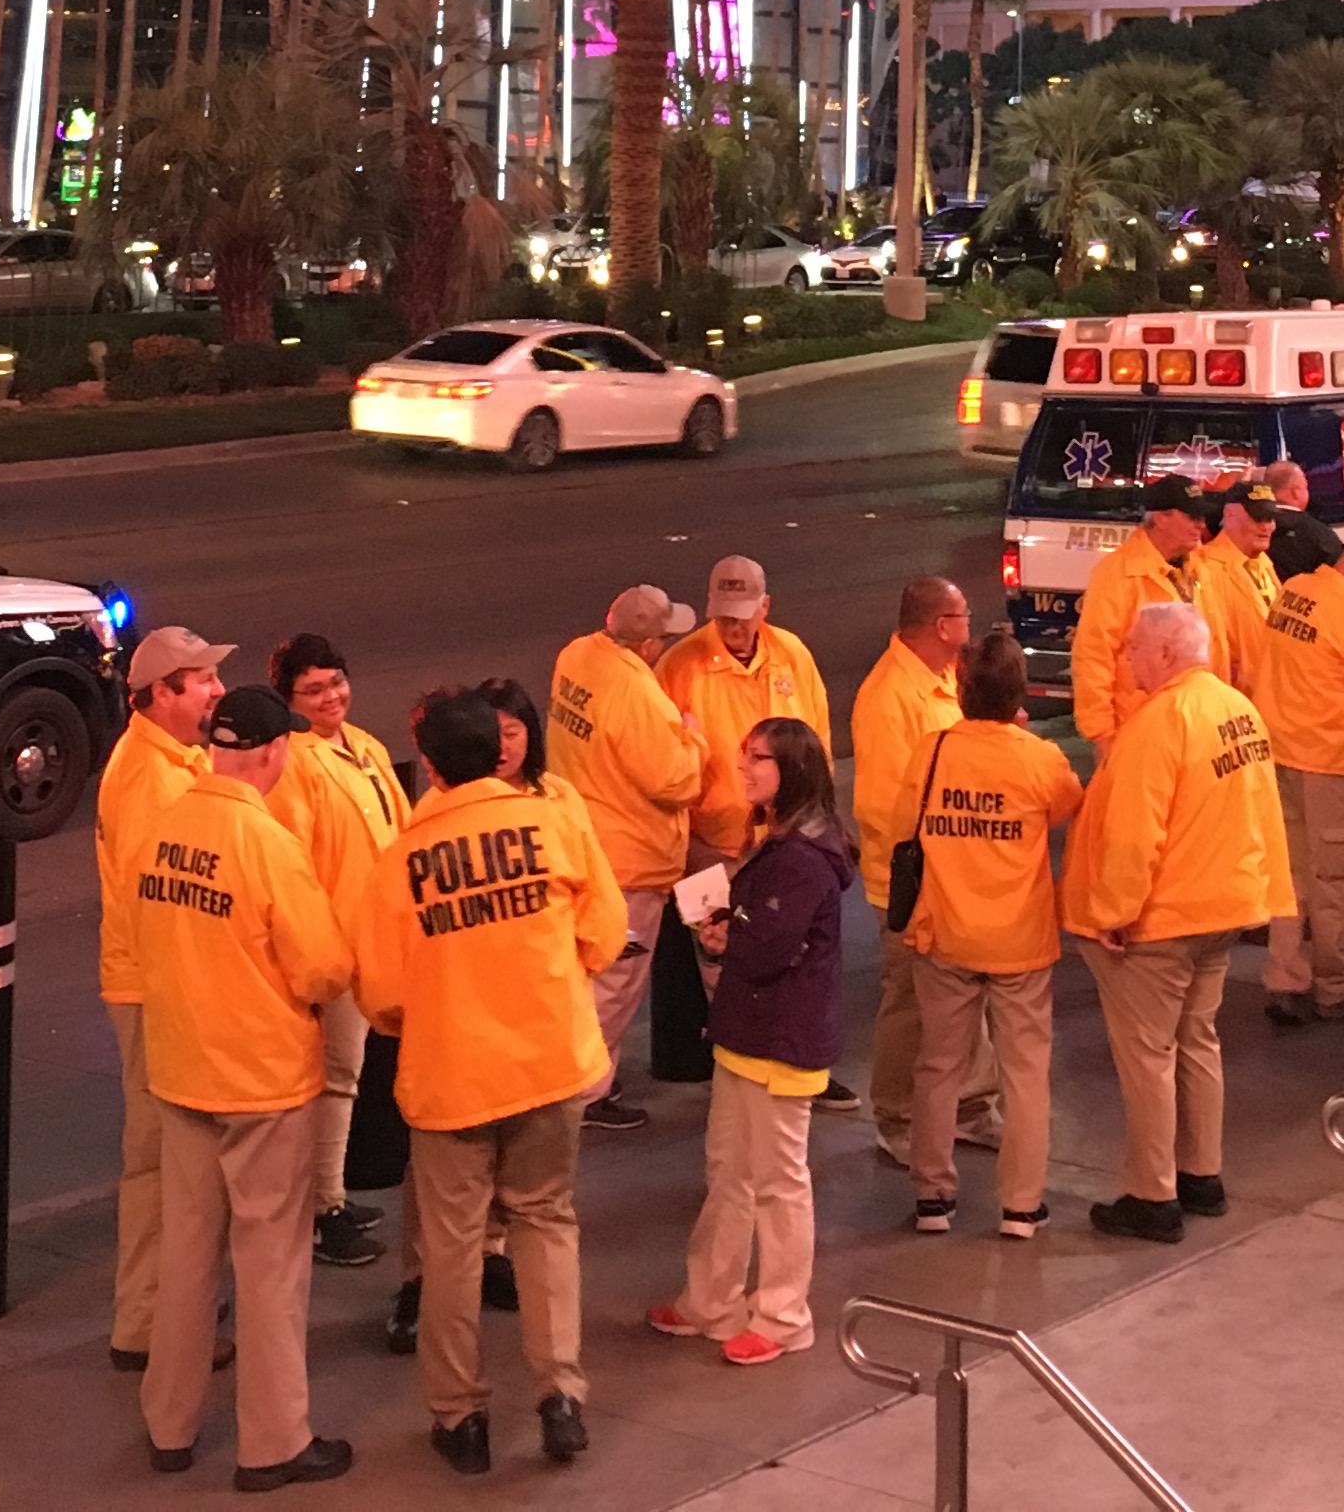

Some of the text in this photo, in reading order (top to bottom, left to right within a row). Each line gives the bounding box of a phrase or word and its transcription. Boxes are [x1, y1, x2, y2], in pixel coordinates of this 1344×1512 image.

[1034, 593, 1066, 614] We
[1217, 714, 1256, 745] POLICE
[1211, 739, 1271, 779] VOLUNTEER
[942, 788, 1005, 813] POLICE
[925, 815, 1023, 841] VOLUNTEER
[155, 841, 221, 880] POLICE
[407, 825, 550, 905] POLICE
[138, 872, 234, 918] VOLUNTEER
[416, 879, 551, 937] VOLUNTEER
